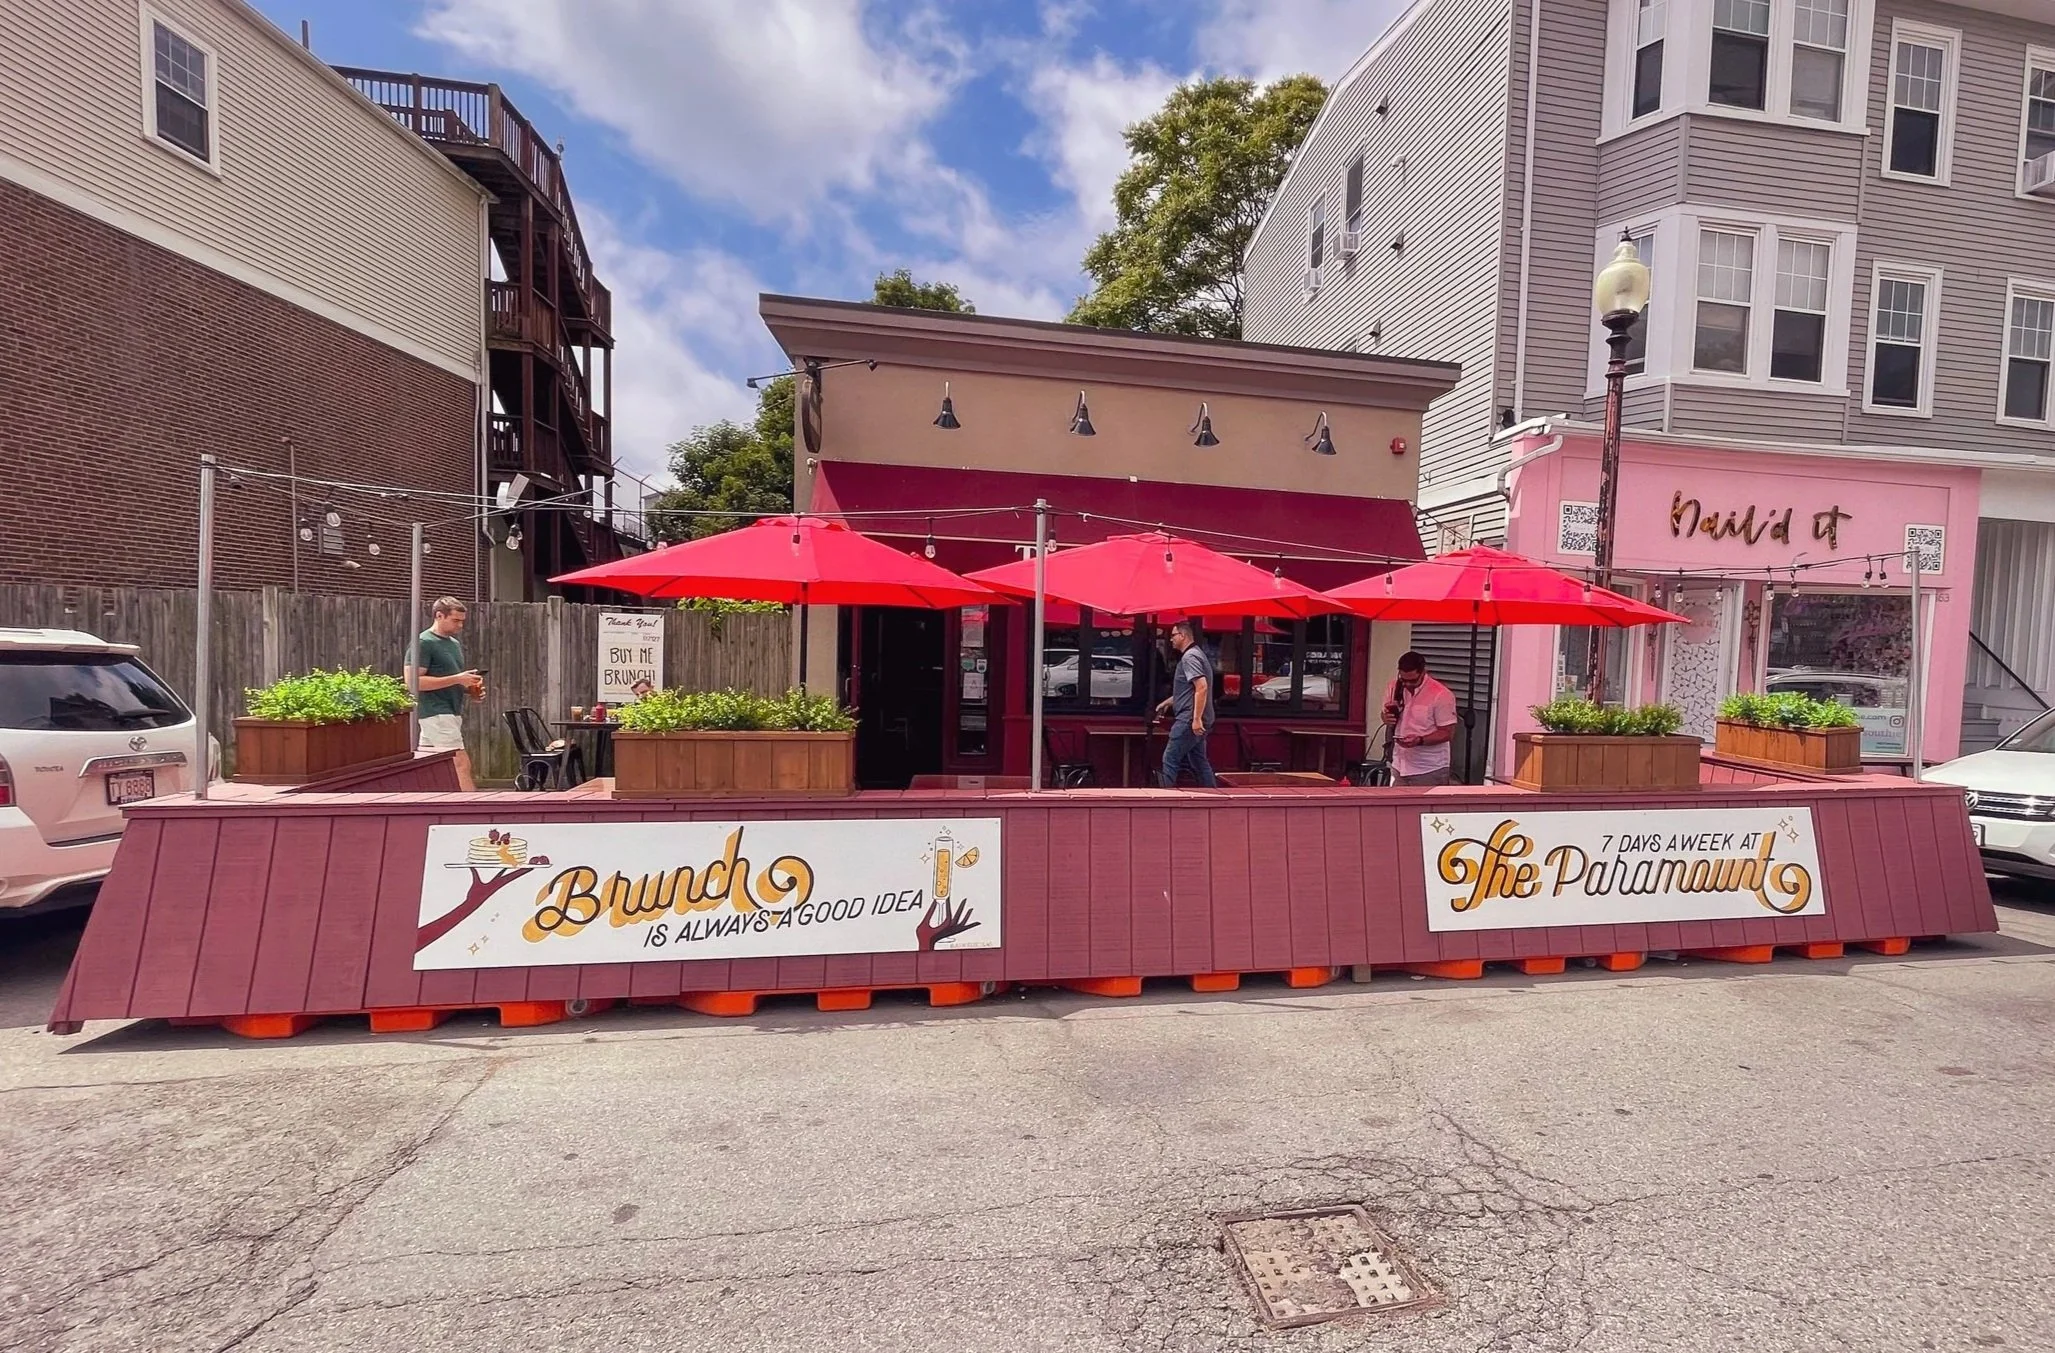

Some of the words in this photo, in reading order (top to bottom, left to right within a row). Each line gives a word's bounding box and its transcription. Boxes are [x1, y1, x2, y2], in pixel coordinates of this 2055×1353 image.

[1812, 504, 1853, 550] it
[605, 616, 632, 627] Thank
[636, 618, 658, 629] You!
[609, 647, 633, 664] BUY
[639, 647, 654, 665] ME
[1601, 834, 1614, 853] 7
[1618, 833, 1661, 853] DAYS
[1739, 832, 1762, 851] AT
[522, 825, 815, 940] Brunch
[1437, 819, 1542, 913] The
[1544, 831, 1812, 914] Paramount
[643, 924, 668, 948] IS
[674, 909, 771, 944] ALWAYS
[776, 906, 797, 928] A
[797, 896, 866, 925] GOOD
[871, 888, 923, 916] IDEA
